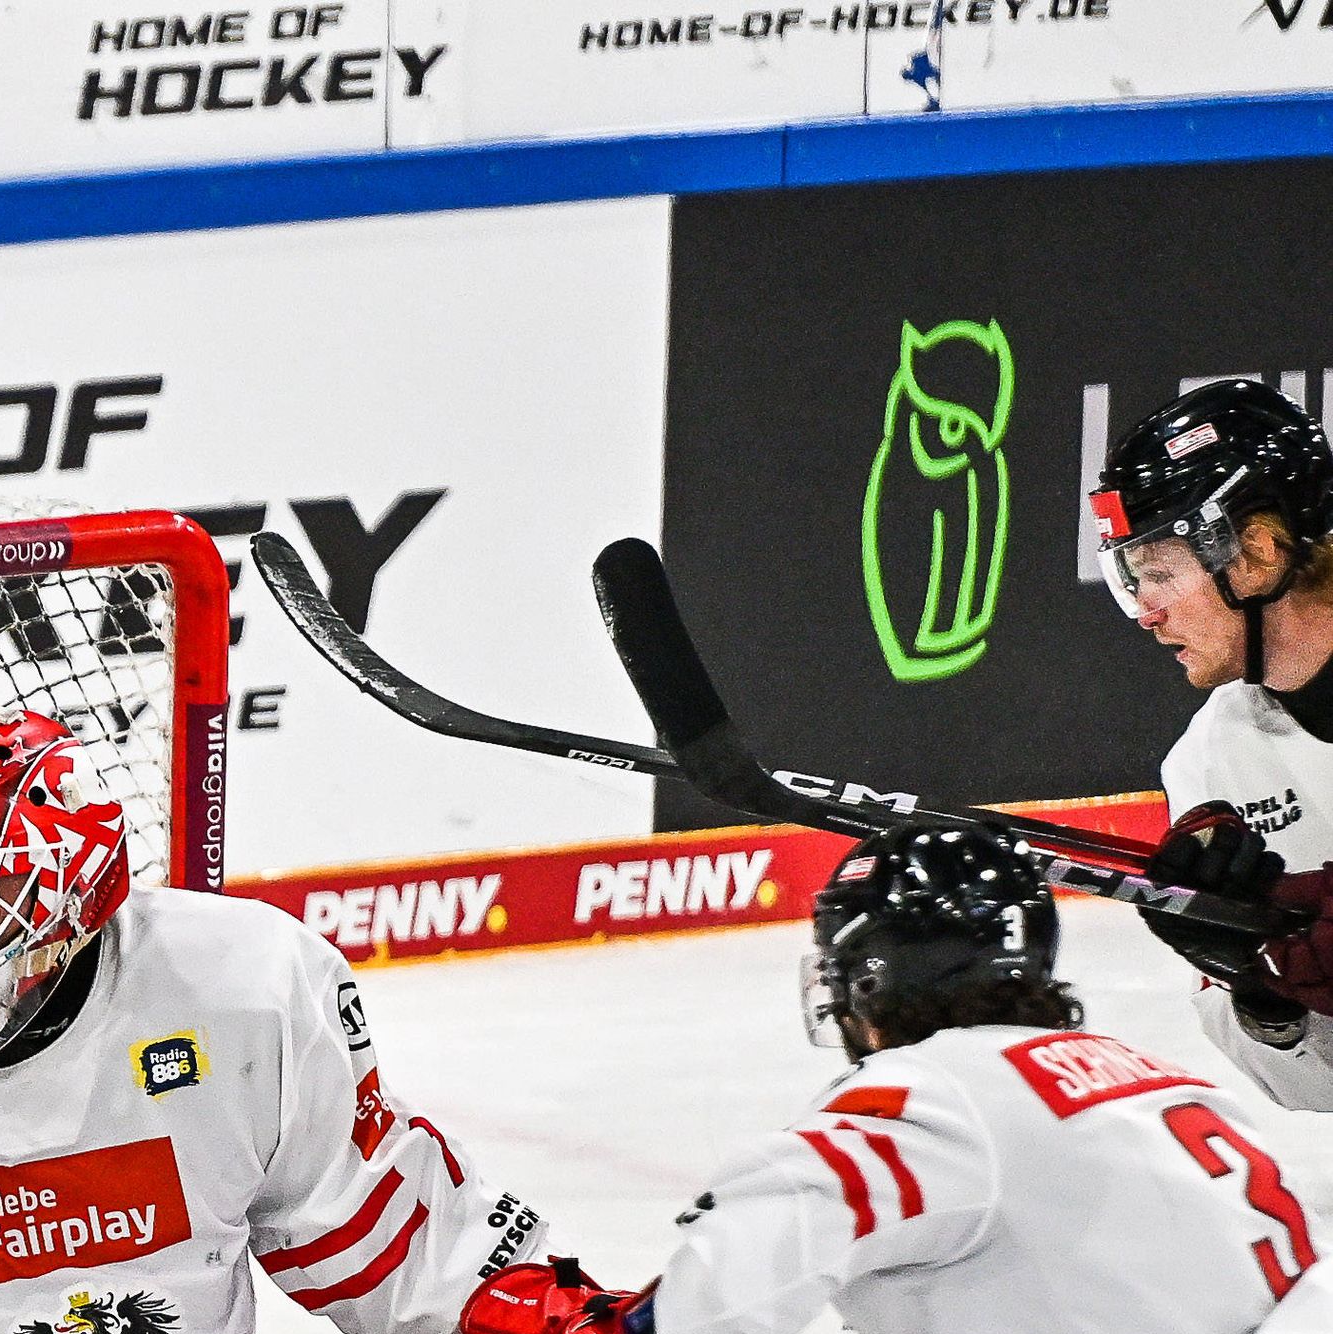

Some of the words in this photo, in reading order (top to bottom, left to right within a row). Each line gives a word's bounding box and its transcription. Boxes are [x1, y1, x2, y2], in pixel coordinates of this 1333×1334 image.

[90, 12, 246, 54] HOME
[270, 5, 342, 40] OF
[77, 43, 448, 121] HOCKEY
[771, 769, 919, 814] CM
[1045, 858, 1198, 912] CM
[1000, 904, 1026, 951] 3
[149, 1047, 189, 1066] Radio
[151, 1059, 192, 1085] 886
